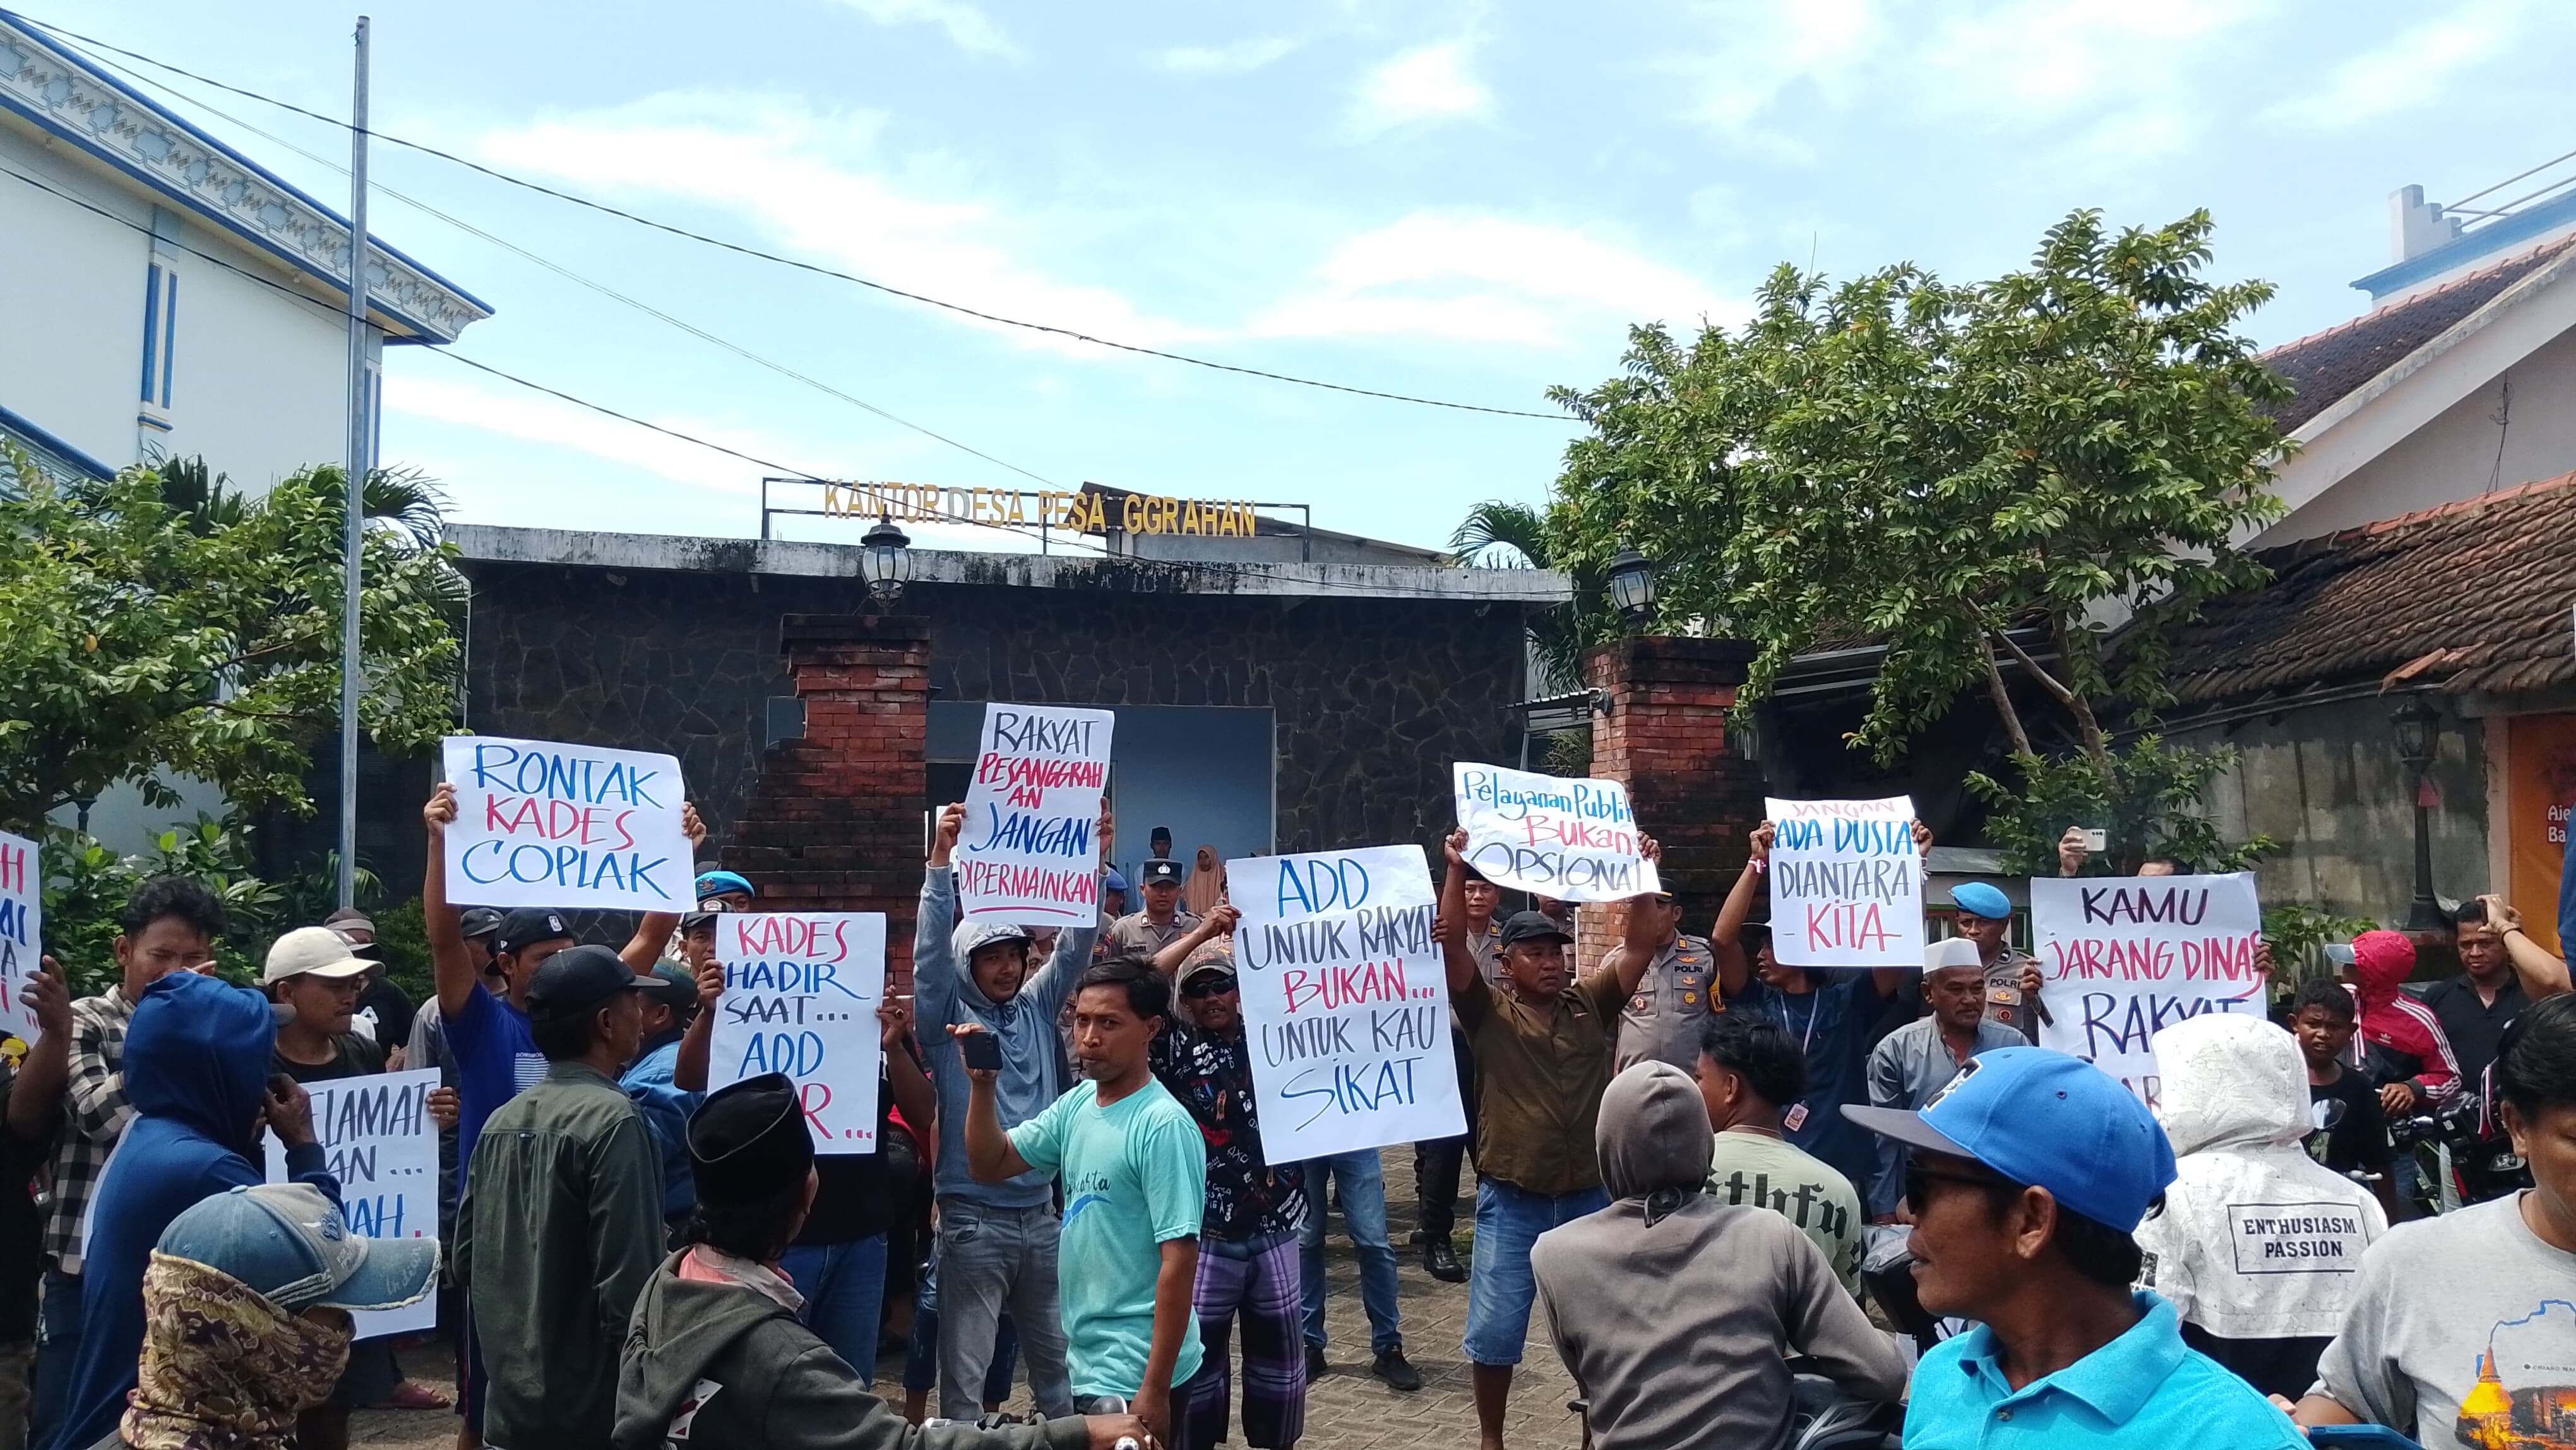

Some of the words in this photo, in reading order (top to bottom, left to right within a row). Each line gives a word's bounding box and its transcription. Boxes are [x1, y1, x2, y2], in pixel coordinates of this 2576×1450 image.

[825, 478, 939, 524] KANTOR
[948, 486, 1025, 529] DESA
[1123, 493, 1256, 538] GGRAHAN
[993, 712, 1100, 757] RAKYAT
[470, 742, 665, 810] RONTAK
[977, 752, 1104, 792] PESANGGRAH
[1464, 771, 1571, 820] Pelayanan
[1006, 787, 1044, 809] AN
[486, 793, 636, 851] KADES
[968, 801, 1091, 858] JANGAN
[1517, 815, 1632, 856] Bukan
[1775, 818, 1825, 851] ADA
[1834, 817, 1913, 858] DUSTA
[462, 839, 672, 901] COPLAK
[959, 859, 1099, 906] DIPERMAINKAN
[1277, 858, 1369, 918] ADD
[1778, 859, 1910, 906] DIANTARA
[2081, 886, 2209, 926] KAMU
[737, 916, 851, 964] KADES
[1241, 918, 1351, 971] UNTUK
[1357, 903, 1439, 961] RAKYAT
[726, 961, 871, 1000] HADIR
[1674, 965, 1703, 973] POLRI
[1989, 978, 2021, 990] POLRI
[1262, 1016, 1354, 1069] UNTUK
[1371, 1005, 1436, 1053] KAU
[2081, 992, 2249, 1059] RAKYT
[737, 1030, 824, 1079] ADD
[310, 1081, 438, 1148] LAMAT
[2242, 1216, 2358, 1235] ENTHUSIASM
[2264, 1240, 2344, 1259] PASSION
